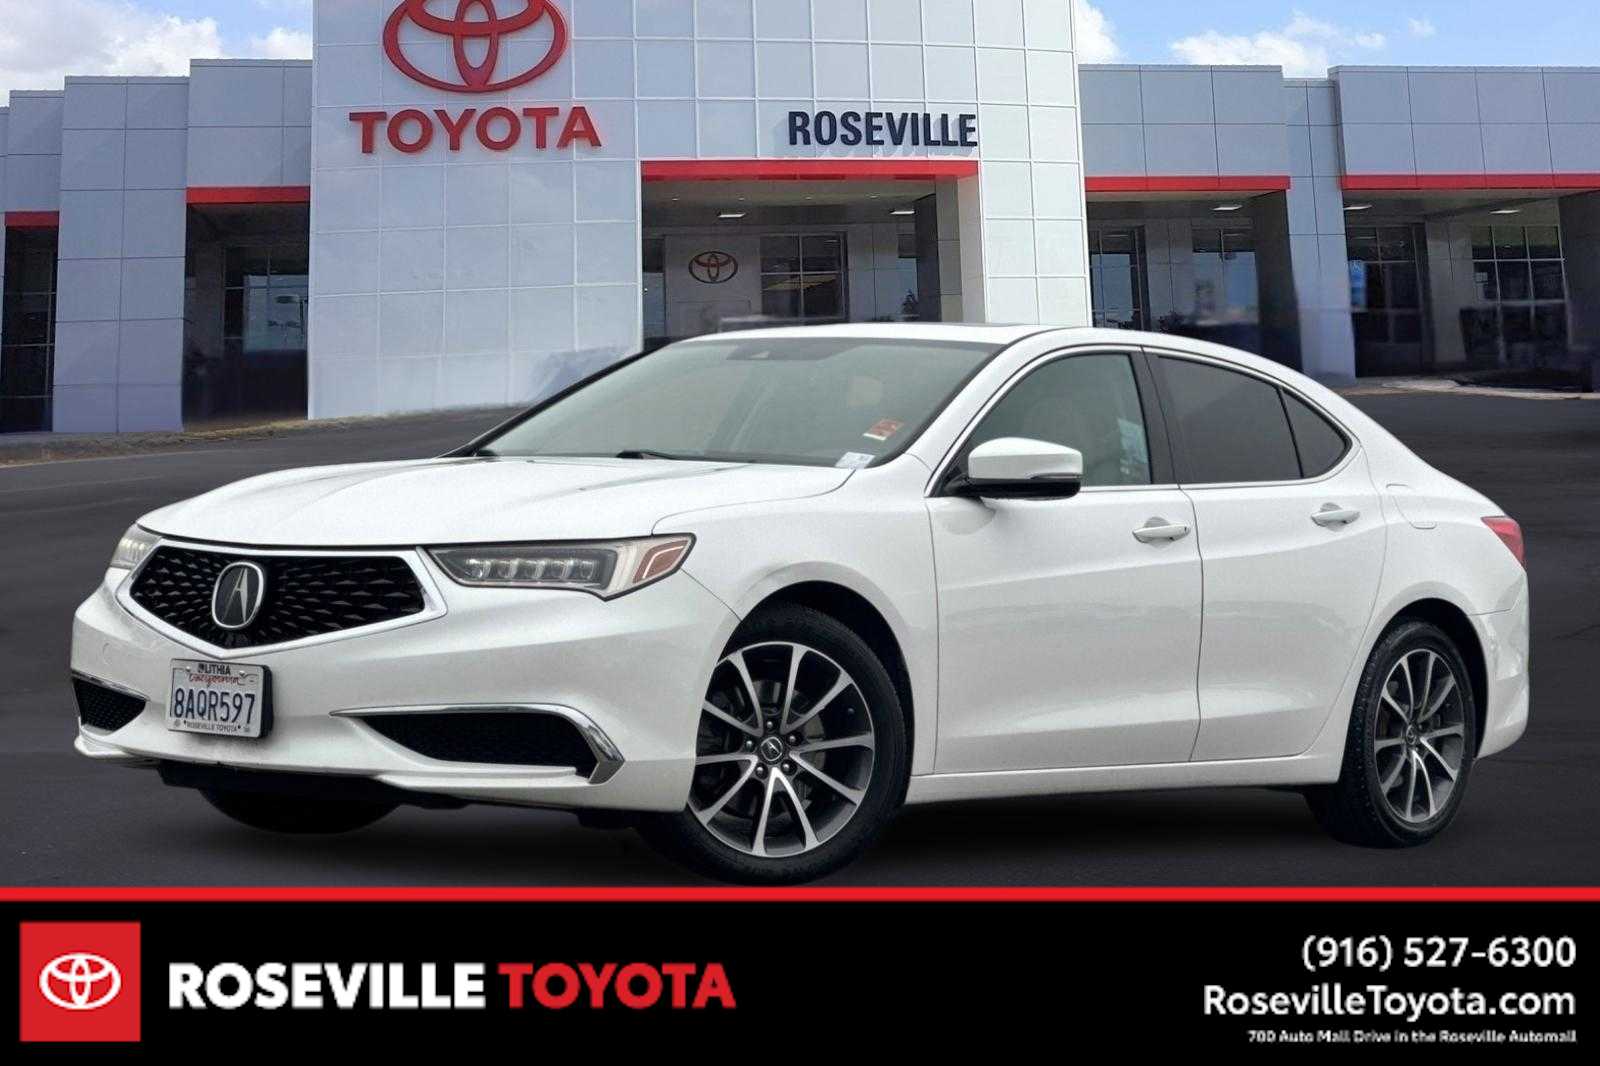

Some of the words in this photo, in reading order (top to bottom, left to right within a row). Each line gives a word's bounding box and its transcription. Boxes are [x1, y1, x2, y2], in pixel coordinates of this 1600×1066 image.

[349, 104, 602, 154] TOYOTA
[788, 111, 978, 147] ROSEVILLE
[204, 663, 231, 675] LITHIA
[173, 687, 256, 725] 8AQR597
